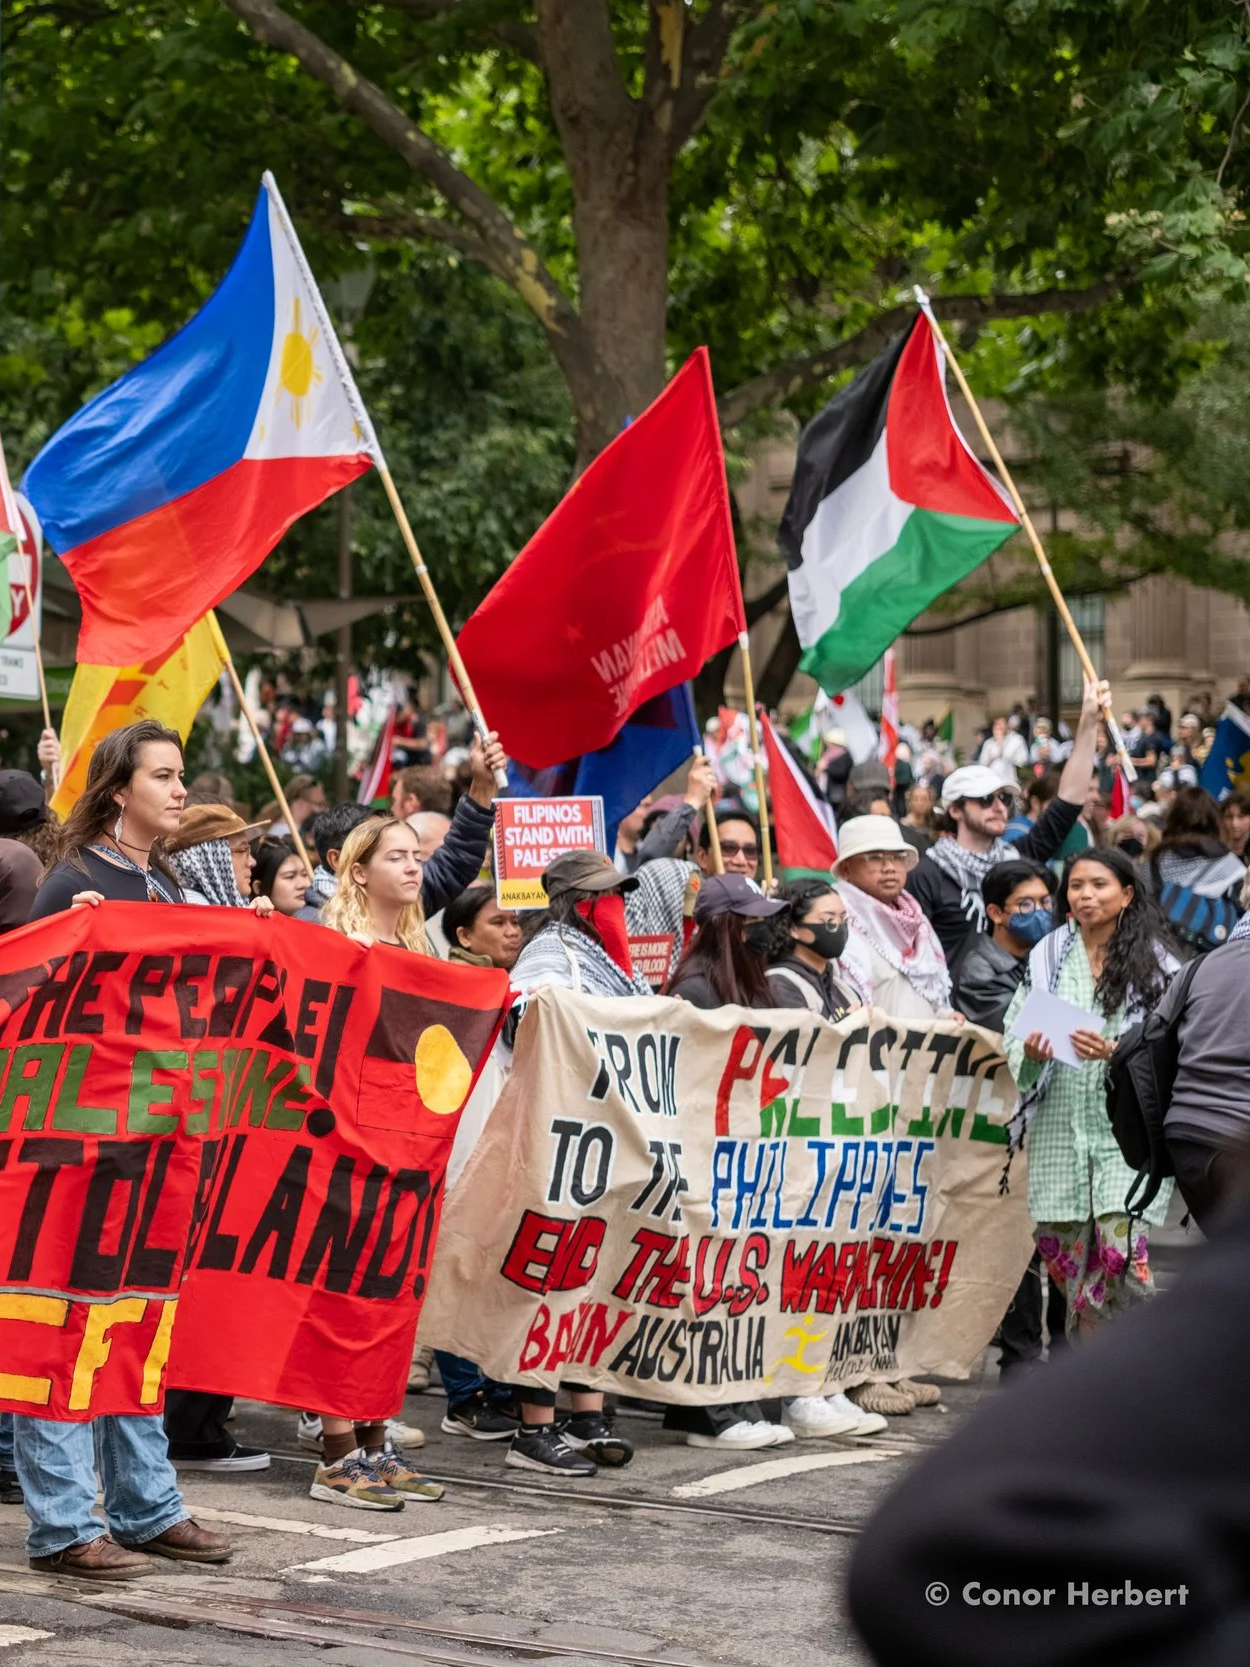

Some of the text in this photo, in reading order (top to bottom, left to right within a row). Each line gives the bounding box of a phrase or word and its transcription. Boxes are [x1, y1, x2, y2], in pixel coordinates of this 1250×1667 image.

[505, 824, 594, 846] STAND WITH
[513, 803, 582, 824] FILIPINOS
[513, 846, 588, 868] PALES
[502, 891, 547, 901] ANAKBAYAN
[715, 1024, 1012, 1146] PALESTINE
[547, 1118, 614, 1208] TO
[197, 1134, 447, 1300] LAND!
[500, 1208, 608, 1299] END
[611, 1226, 691, 1309] THE
[692, 1231, 771, 1319] U.S.
[518, 1298, 636, 1374] BAN
[608, 1314, 766, 1385] AUSTRALIA
